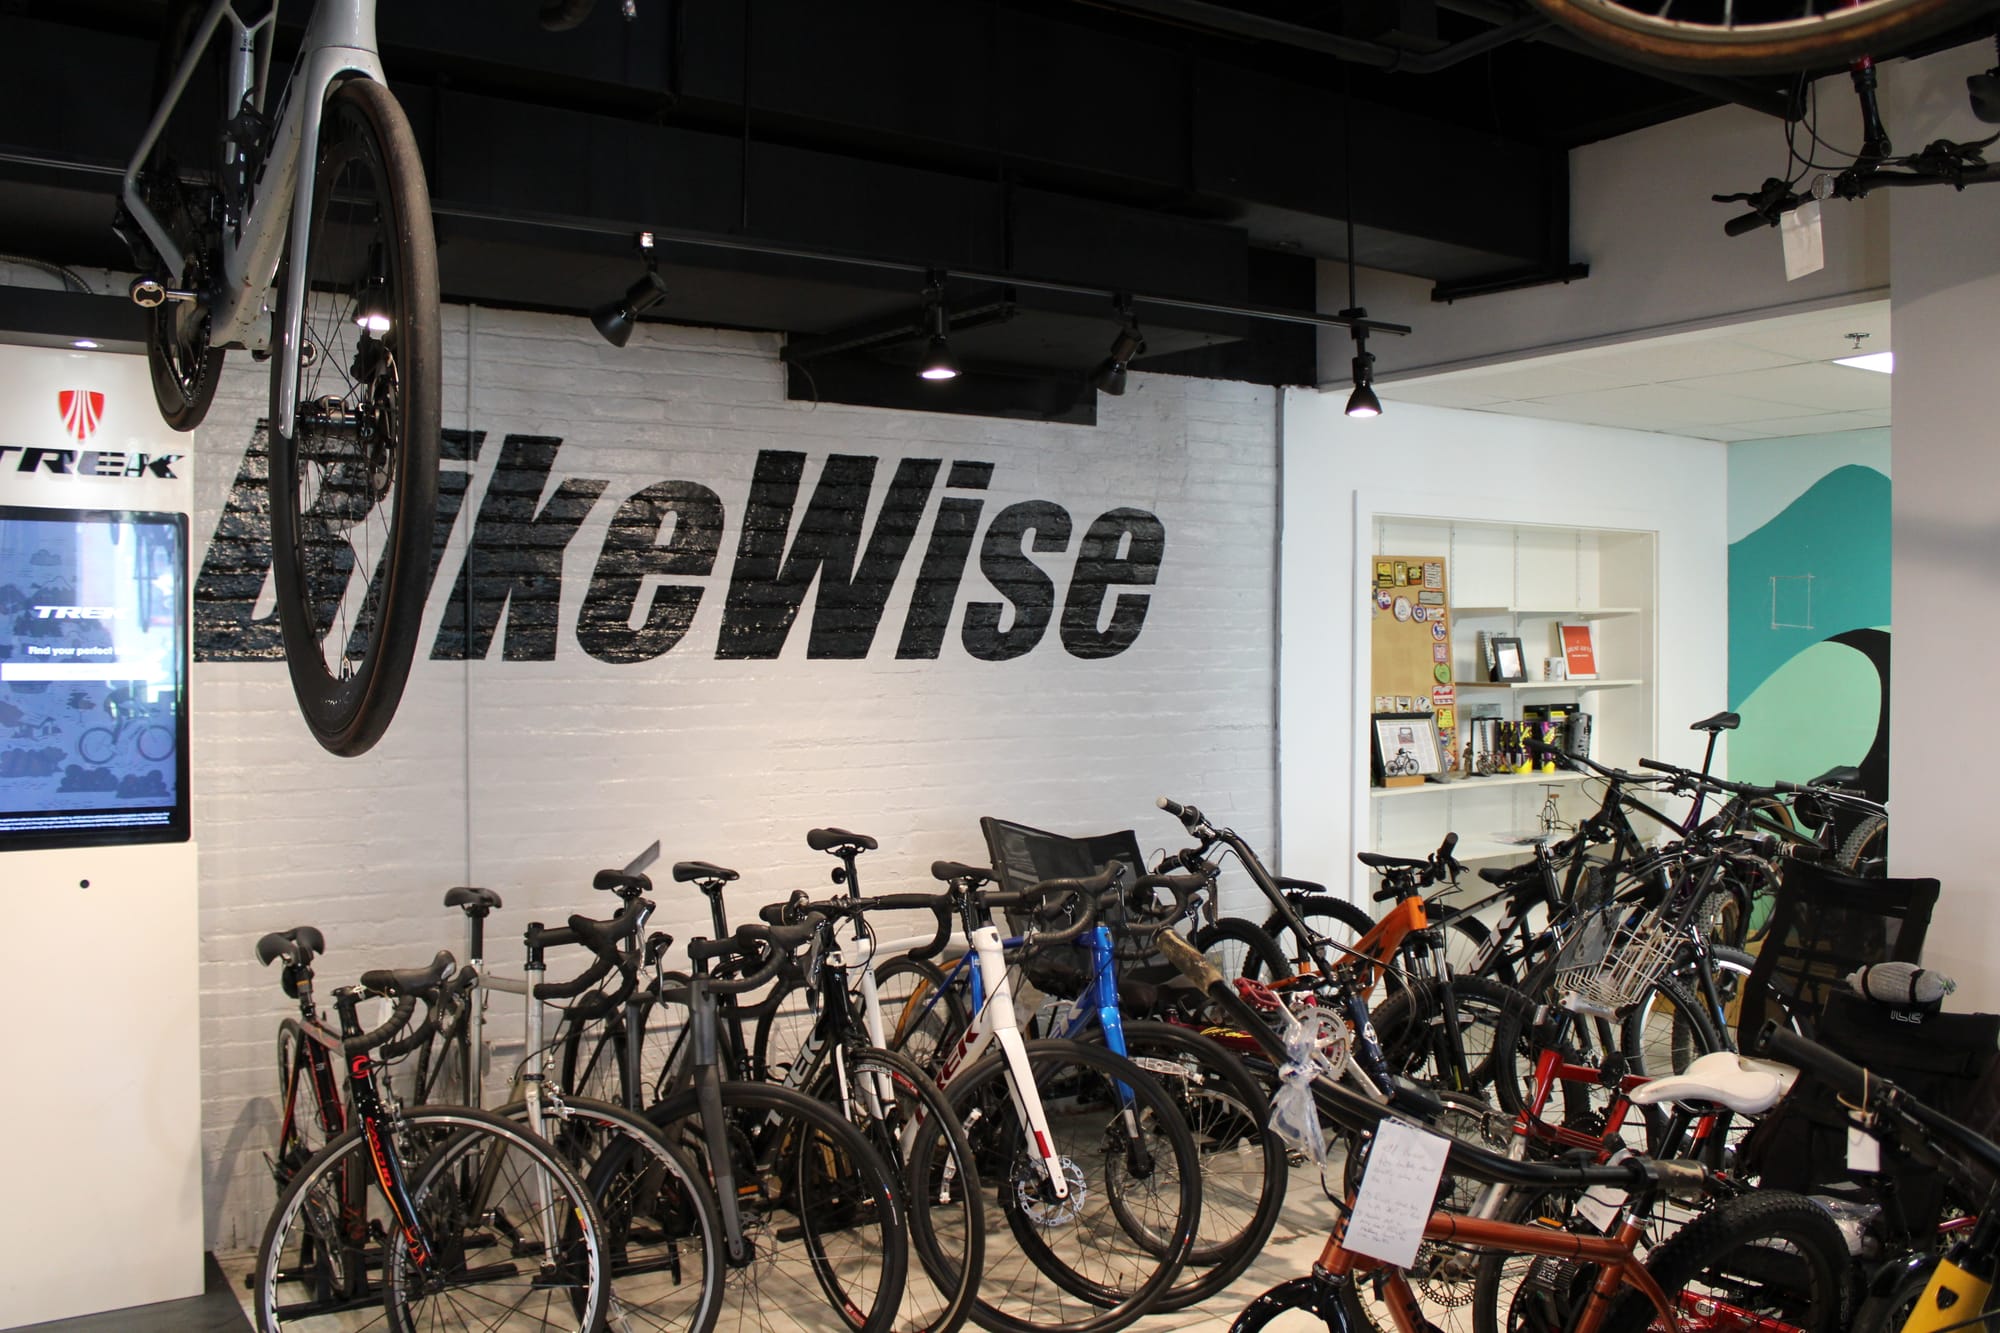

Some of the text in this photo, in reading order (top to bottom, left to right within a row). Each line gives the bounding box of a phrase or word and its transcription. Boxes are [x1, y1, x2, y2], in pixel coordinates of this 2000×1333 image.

[28, 646, 51, 656] Find
[53, 647, 74, 657] your
[77, 646, 113, 657] perfect
